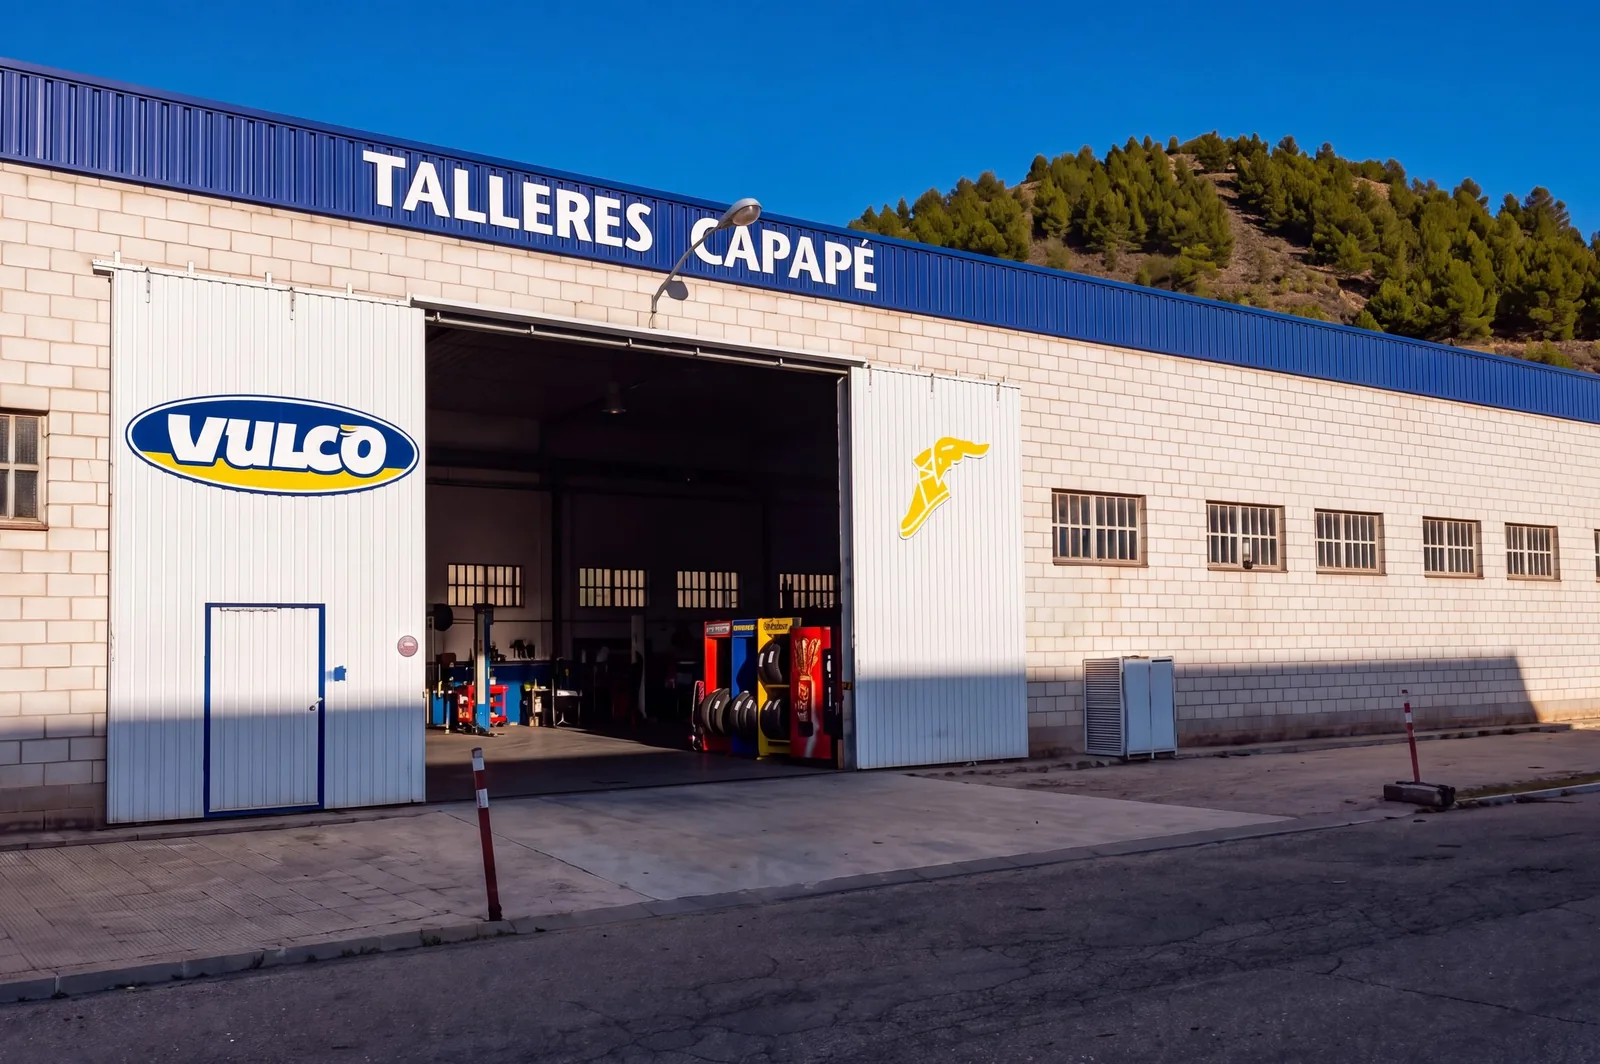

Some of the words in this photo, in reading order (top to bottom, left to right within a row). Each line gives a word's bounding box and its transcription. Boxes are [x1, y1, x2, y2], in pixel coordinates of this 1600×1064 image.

[363, 150, 653, 252] TALLERES
[691, 217, 877, 292] CAPAPÉ
[168, 413, 387, 475] VULCO
